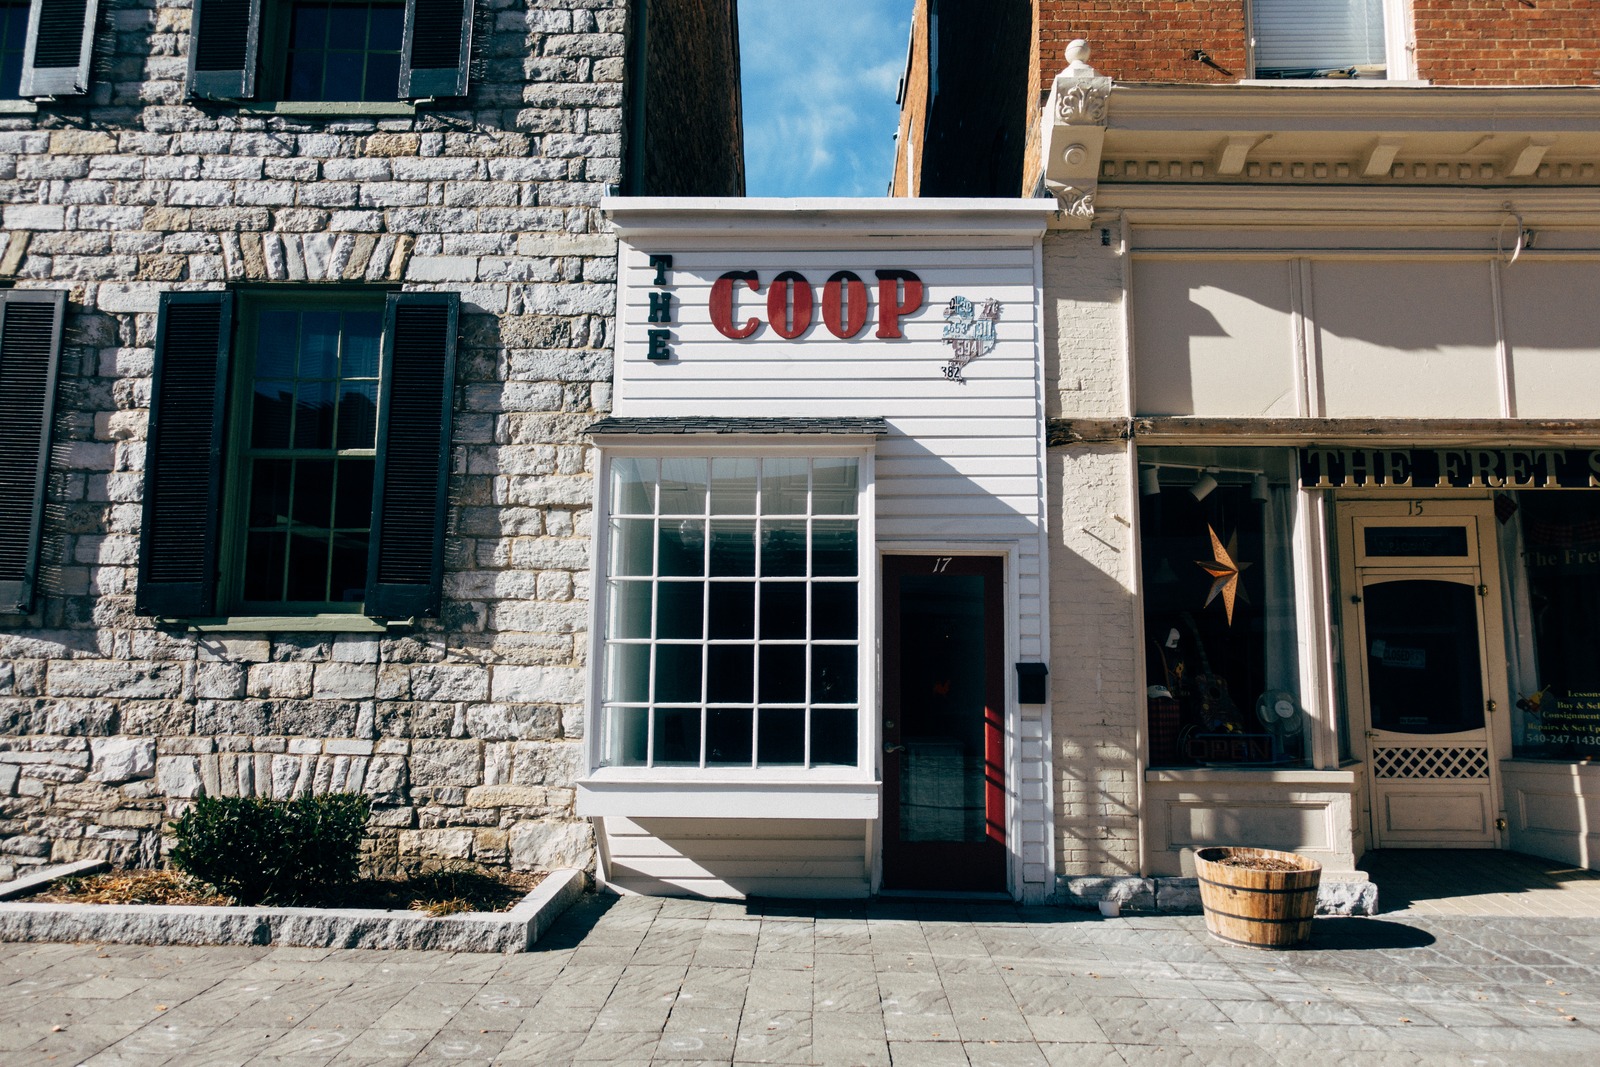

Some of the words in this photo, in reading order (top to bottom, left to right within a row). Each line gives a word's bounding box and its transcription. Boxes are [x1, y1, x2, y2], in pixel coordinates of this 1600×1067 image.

[647, 254, 673, 360] THE
[708, 269, 925, 340] COOP
[1307, 450, 1412, 488] THE
[1435, 450, 1567, 488] FRET
[1408, 500, 1424, 516] 15
[932, 557, 953, 573] 17
[1520, 551, 1558, 567] The
[1557, 701, 1573, 710] Buy
[1576, 702, 1584, 710] &
[1527, 722, 1560, 731] Repairs
[1187, 739, 1270, 760] OPEN
